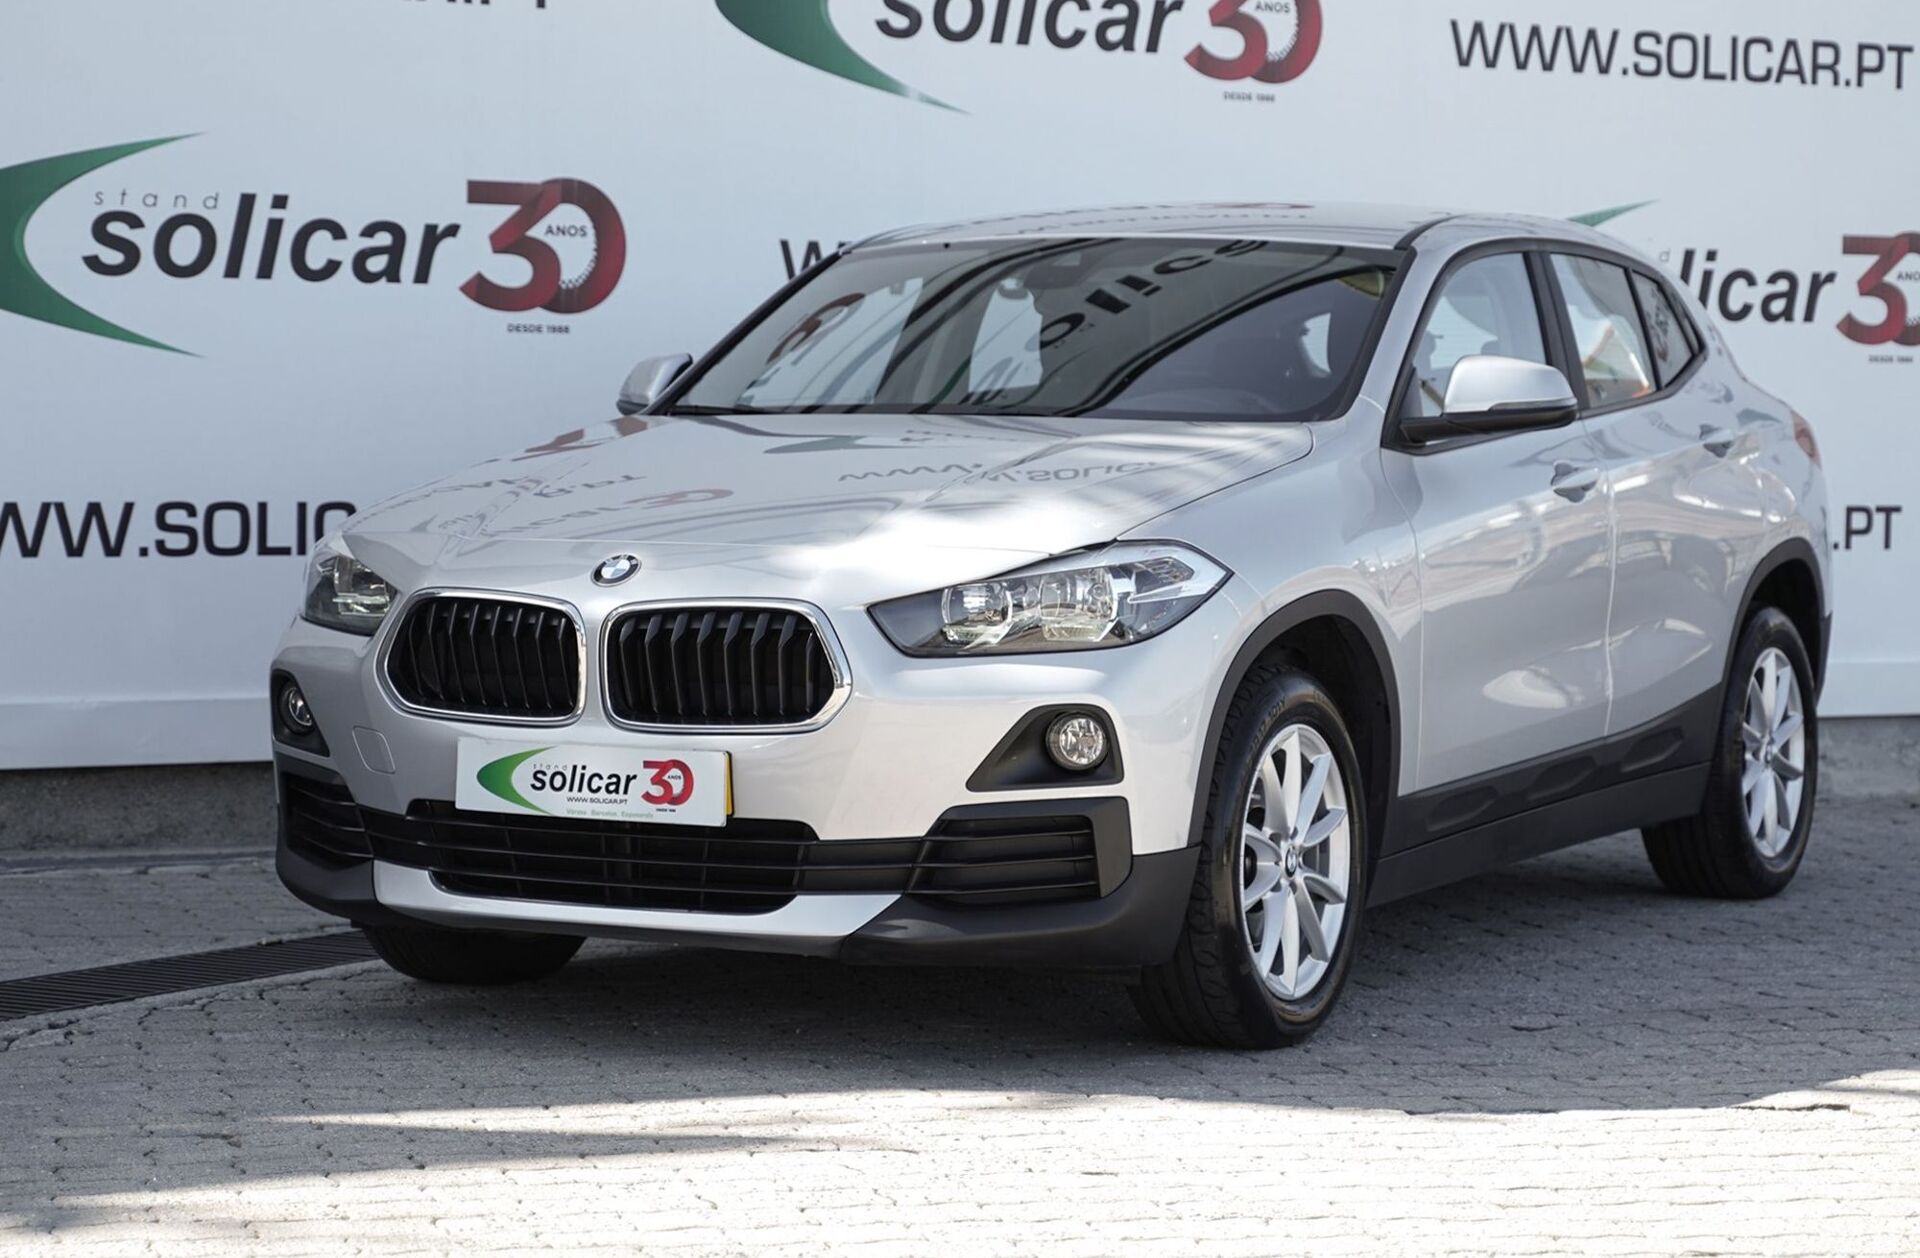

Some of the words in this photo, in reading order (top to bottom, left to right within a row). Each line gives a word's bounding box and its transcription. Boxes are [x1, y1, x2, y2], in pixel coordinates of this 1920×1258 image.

[1255, 1, 1291, 13] ANOS
[1450, 19, 1914, 90] WWW.SOLICAR.PT
[94, 188, 220, 211] stand
[81, 192, 461, 285] solicar
[458, 177, 627, 314] 30
[544, 224, 588, 238] ANOS
[1896, 271, 1920, 283] ANO
[0, 500, 357, 558] WW.SOLIC
[1832, 506, 1902, 550] .PT
[530, 765, 638, 795] solicar
[640, 758, 694, 806] 30
